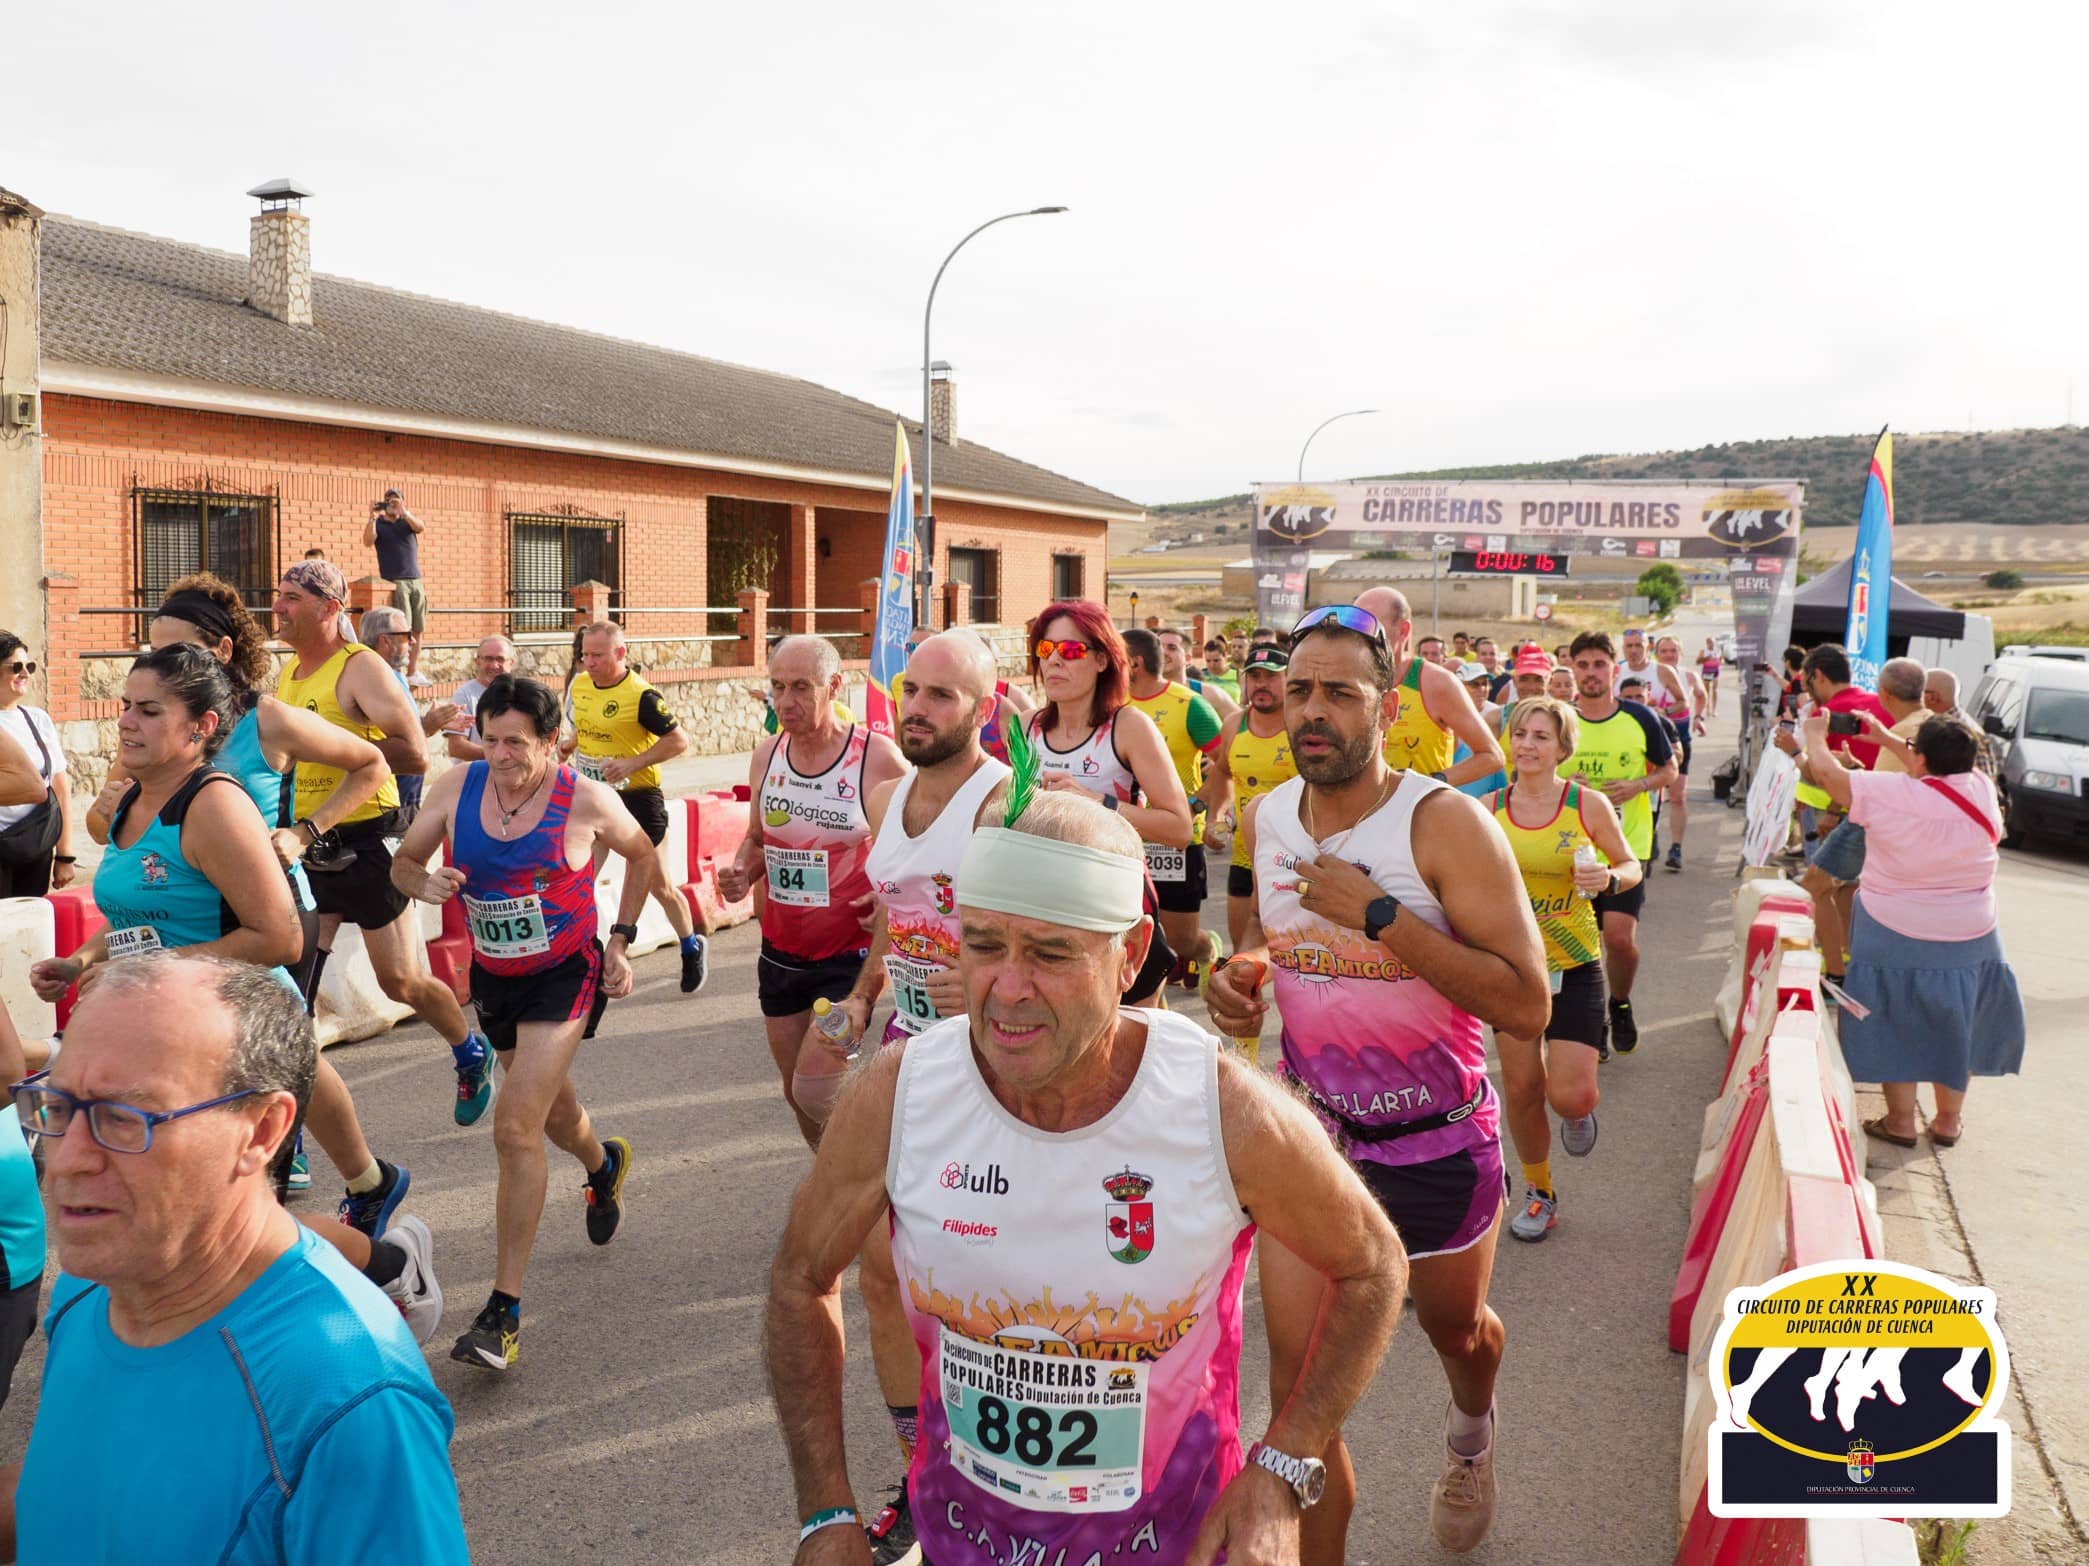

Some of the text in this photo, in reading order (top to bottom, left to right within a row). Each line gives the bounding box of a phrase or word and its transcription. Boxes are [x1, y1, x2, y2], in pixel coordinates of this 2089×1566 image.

[1383, 487, 1432, 498] CIRCUITO
[1435, 487, 1448, 497] DE
[1362, 498, 1681, 529] CARRERAS POPULARES
[816, 820, 854, 831] rujamar
[1145, 856, 1183, 870] 2039
[779, 867, 805, 890] 84
[479, 900, 519, 913] CARRERAS
[476, 917, 533, 942] 1013
[971, 1164, 1009, 1195] ulb
[943, 1219, 998, 1237] Filipides
[950, 1344, 982, 1366] CIRCUITO
[984, 1354, 992, 1369] DE
[994, 1353, 1097, 1387] CARRERAS
[943, 1358, 1141, 1405] POPULARES Diputación de Cuenca
[976, 1396, 1098, 1467] 882
